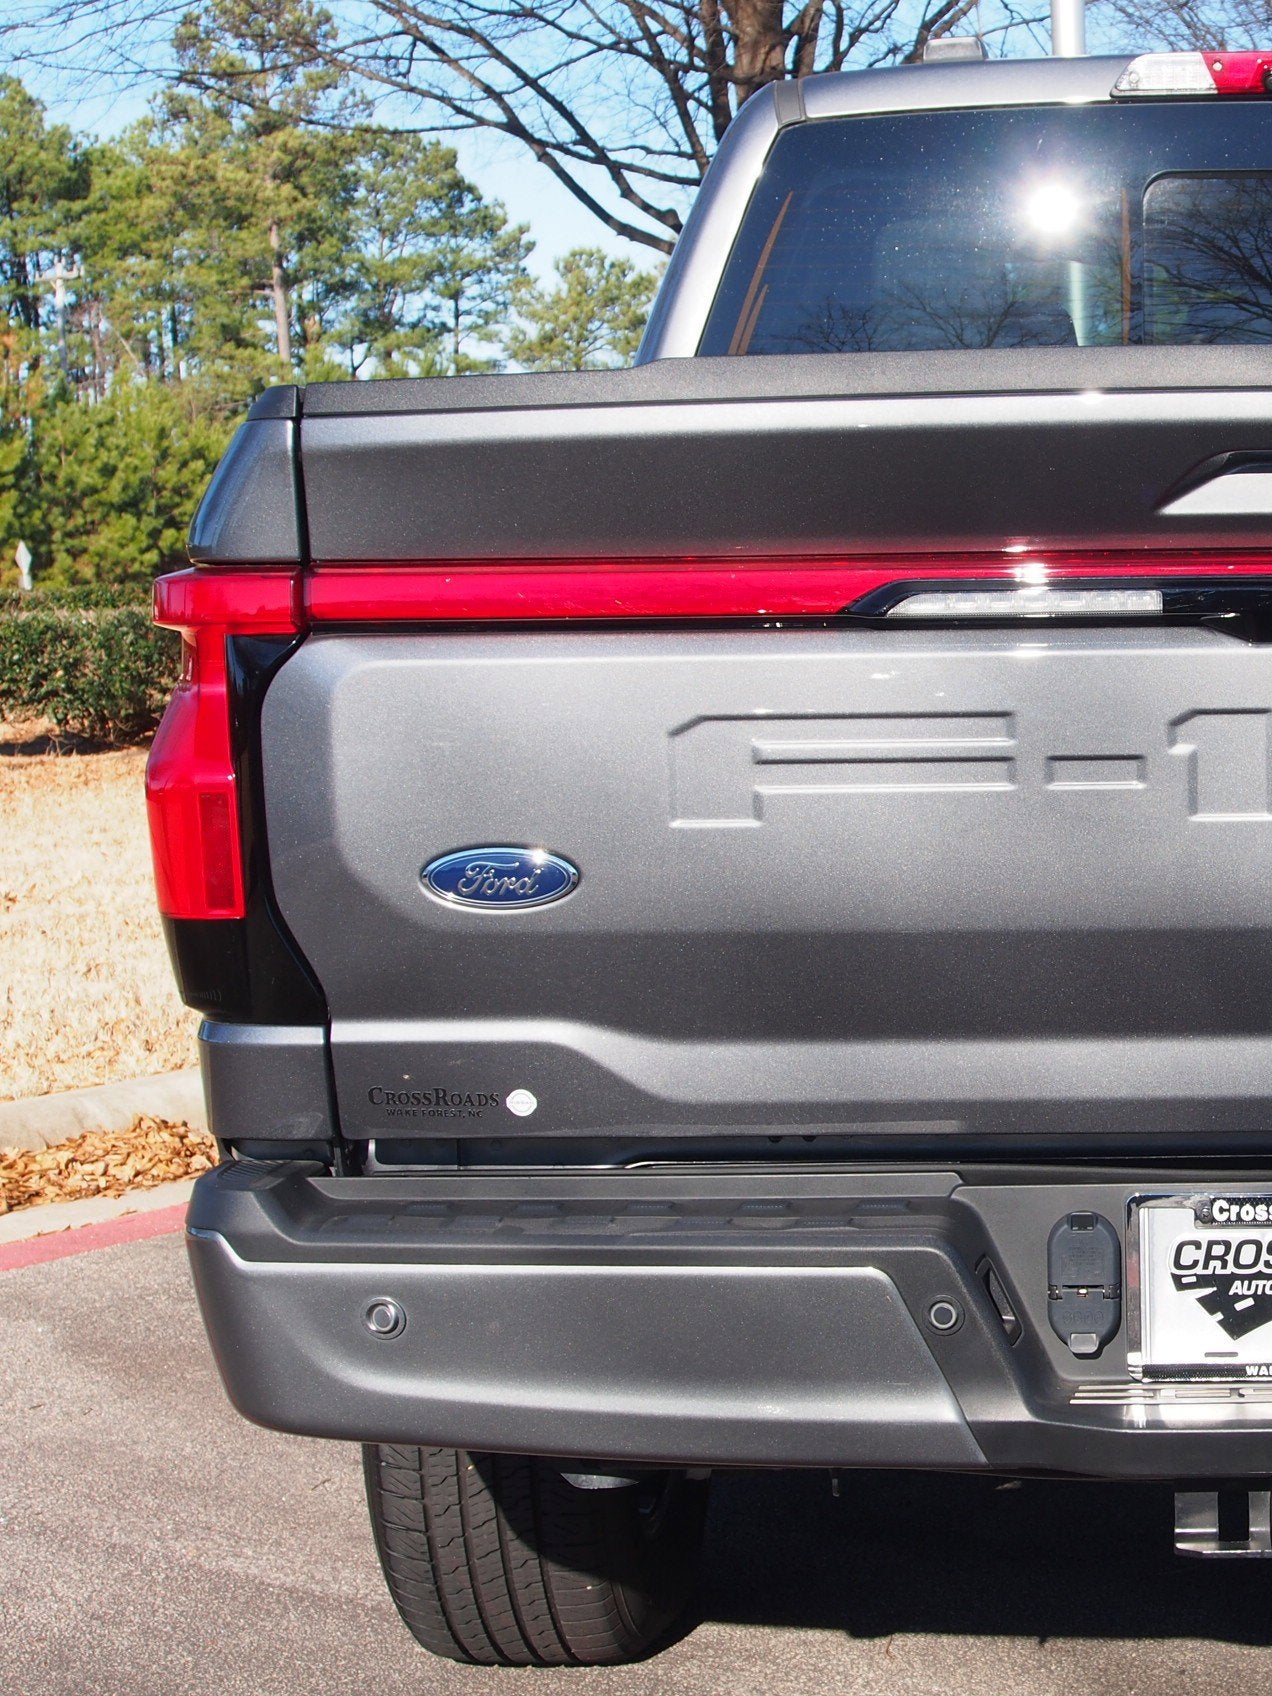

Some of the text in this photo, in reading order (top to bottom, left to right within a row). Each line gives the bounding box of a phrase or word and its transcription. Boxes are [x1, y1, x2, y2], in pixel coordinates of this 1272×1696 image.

[457, 860, 544, 896] Ford
[386, 1108, 418, 1117] WAKE
[469, 1109, 483, 1118] NC
